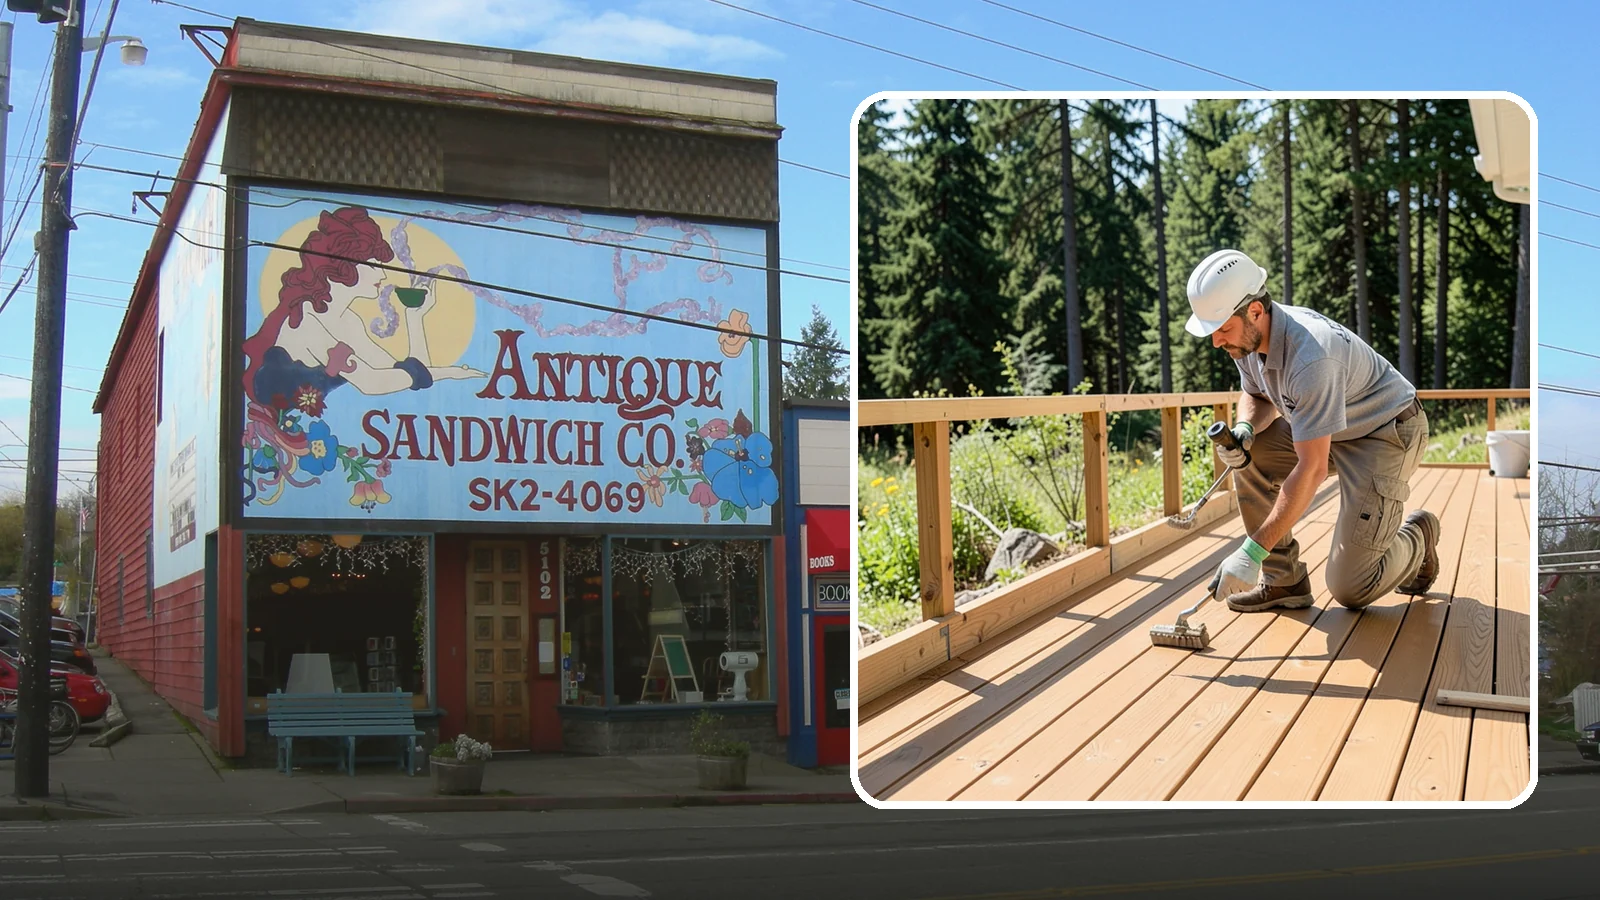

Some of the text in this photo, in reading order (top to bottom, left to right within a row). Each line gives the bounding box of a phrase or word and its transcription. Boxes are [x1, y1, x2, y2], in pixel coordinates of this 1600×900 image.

[477, 329, 723, 420] ANTIQUE
[361, 408, 684, 469] SANDWICH CO.
[468, 477, 646, 513] SK2-4069
[540, 541, 551, 599] 5102
[809, 555, 834, 568] BOOKS
